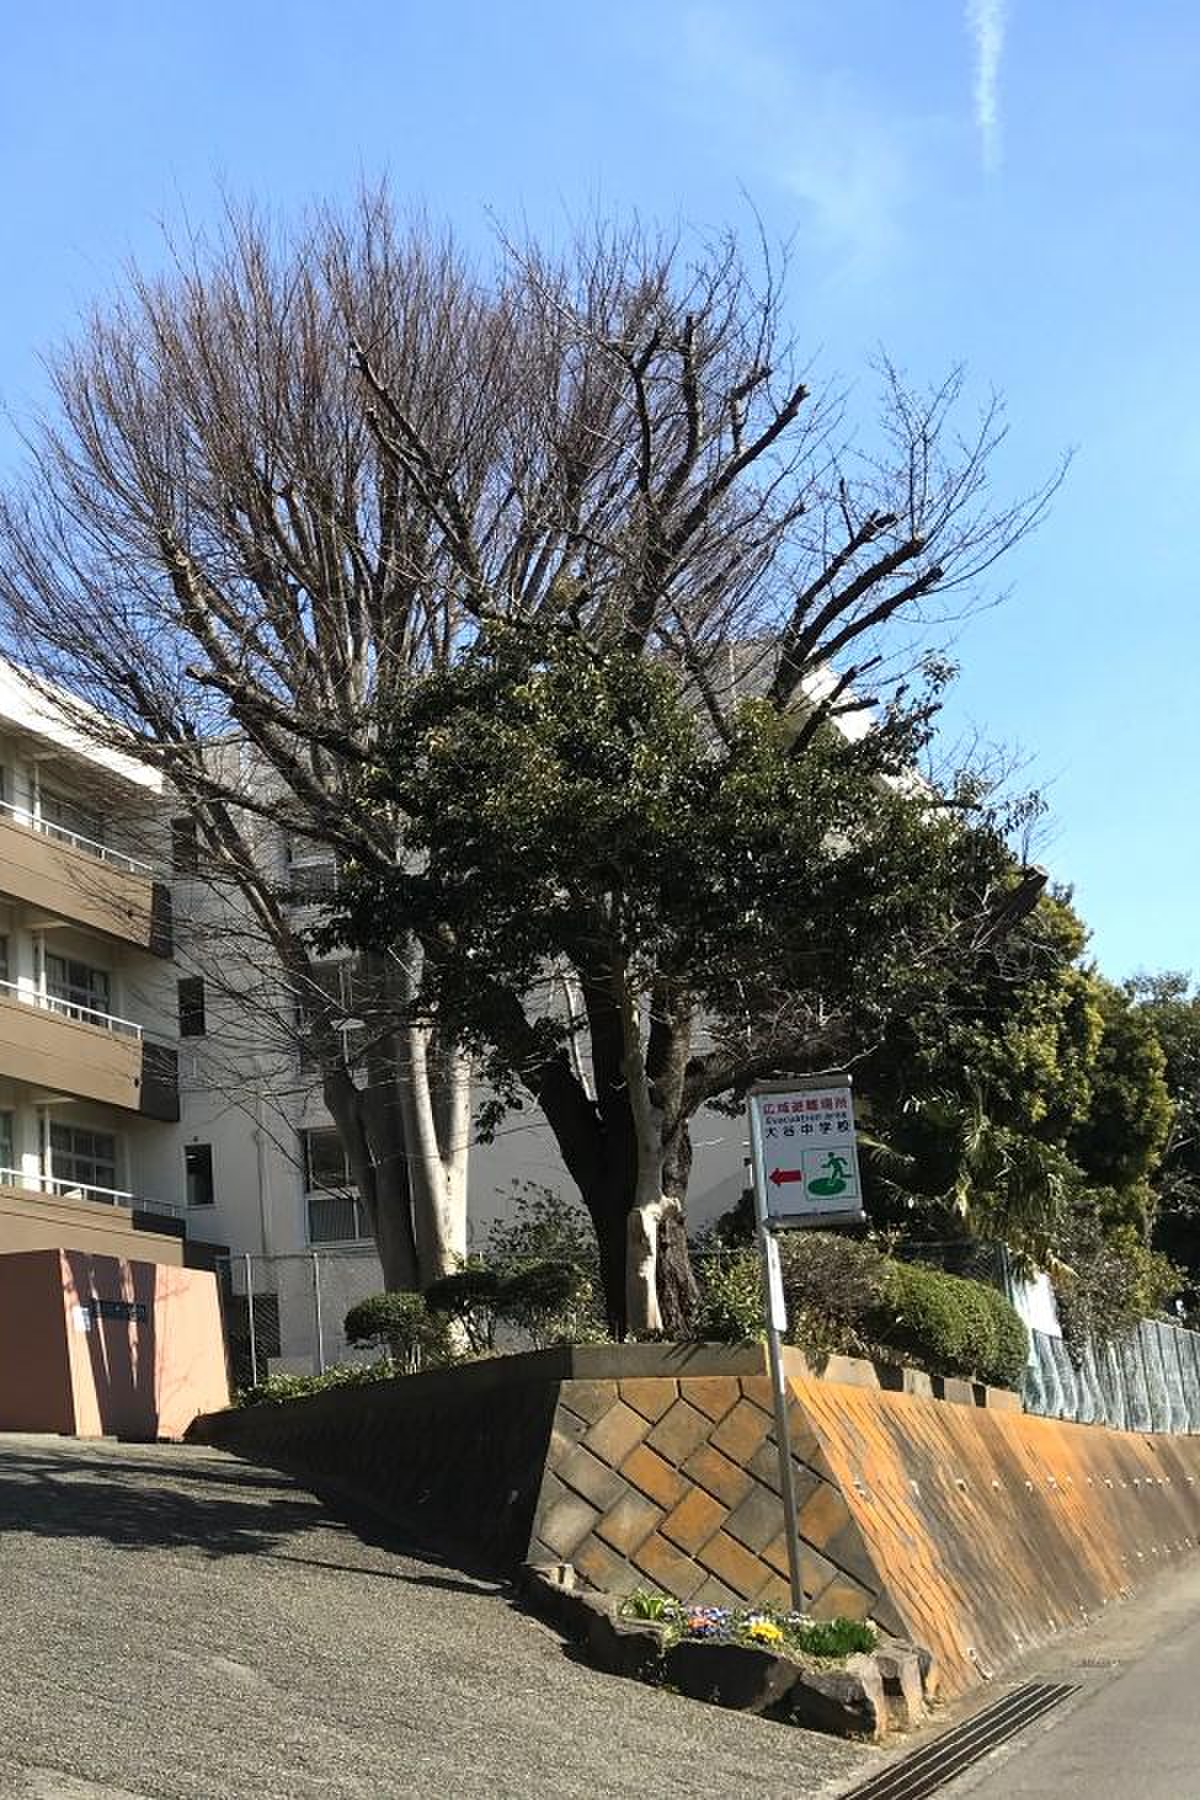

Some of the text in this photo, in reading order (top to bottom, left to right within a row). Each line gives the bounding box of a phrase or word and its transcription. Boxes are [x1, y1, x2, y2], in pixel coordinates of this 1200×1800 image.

[765, 1113, 820, 1124] Evacuation
[765, 1120, 849, 1138] 大谷中学校
